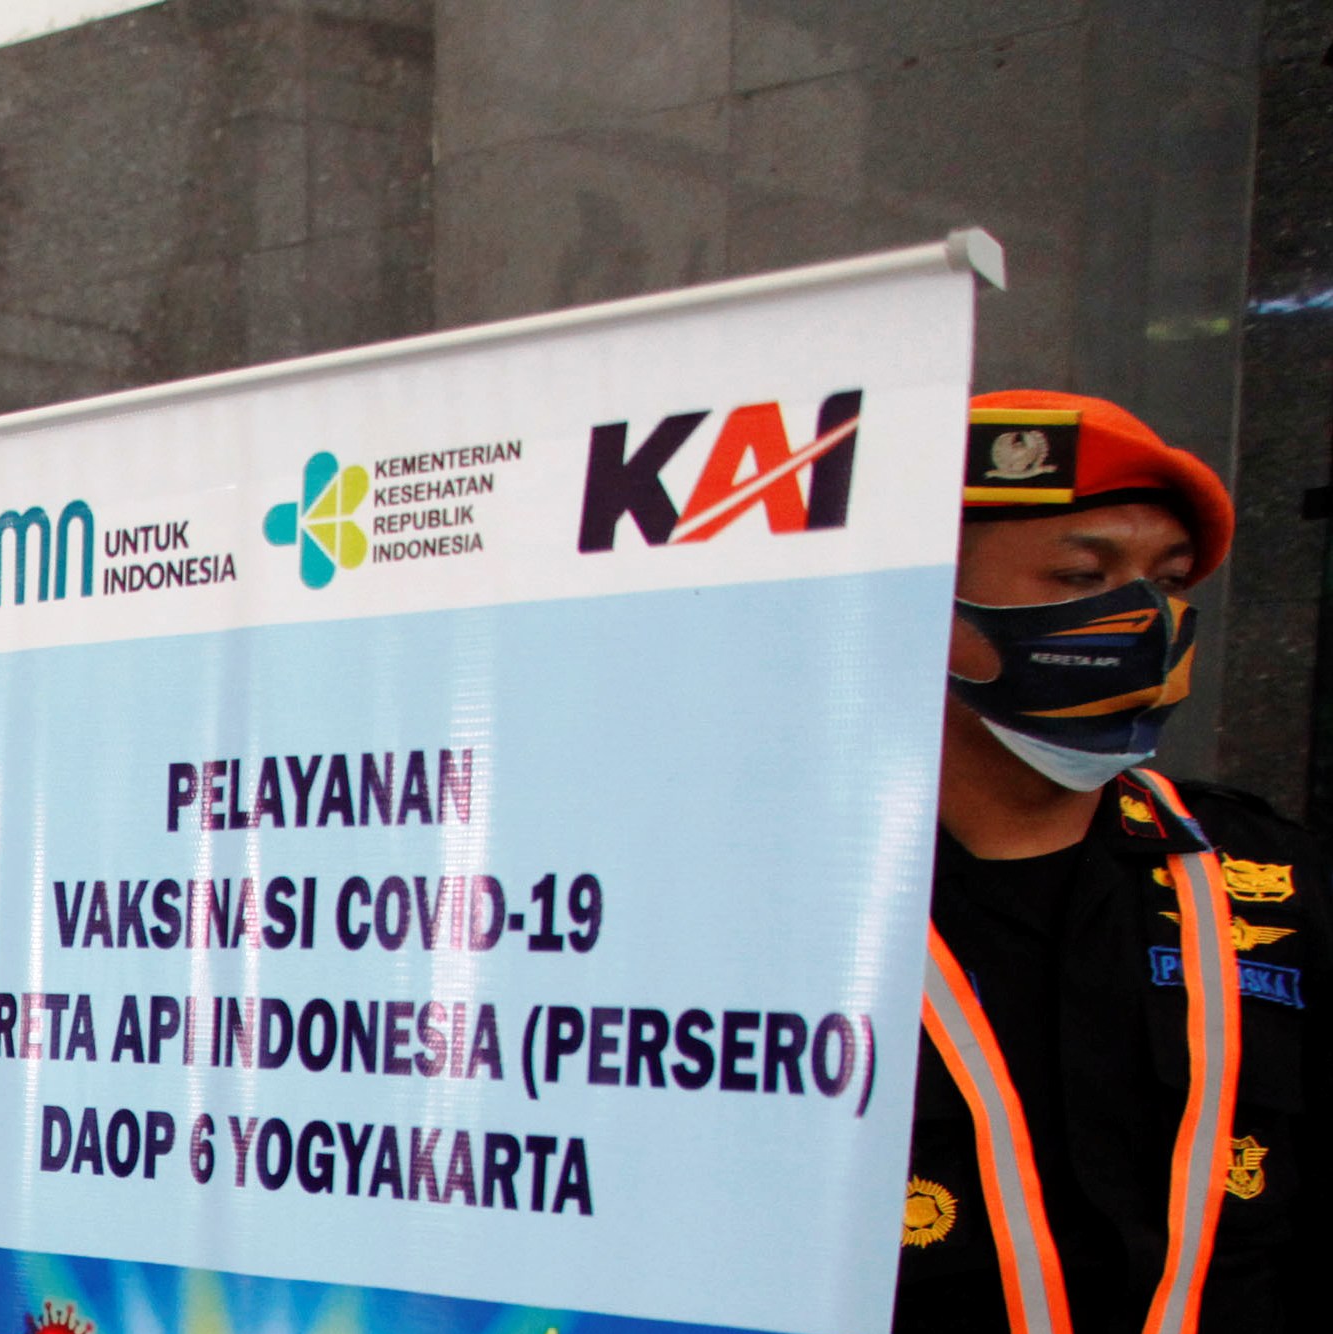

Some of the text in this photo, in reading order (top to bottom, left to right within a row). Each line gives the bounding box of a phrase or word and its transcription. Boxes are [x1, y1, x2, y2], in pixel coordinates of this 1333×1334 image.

[374, 440, 522, 479] KEMENTERIAN
[577, 388, 863, 554] KAI
[373, 473, 494, 508] KESEHATAN
[104, 520, 189, 557] UNTUK
[373, 505, 474, 536] REPUBLIK
[372, 533, 484, 563] INDONESIA
[103, 553, 237, 596] INDONESIA
[1030, 651, 1093, 666] KERETA
[168, 749, 473, 832] PELAYANAN
[54, 873, 602, 953] VAKSINASI COVID-19
[112, 996, 195, 1066] API
[211, 996, 503, 1081] INDONESIA
[522, 1005, 876, 1117] (PERSERO)
[41, 1106, 594, 1217] DAOP 6 YOGYAKARTA
